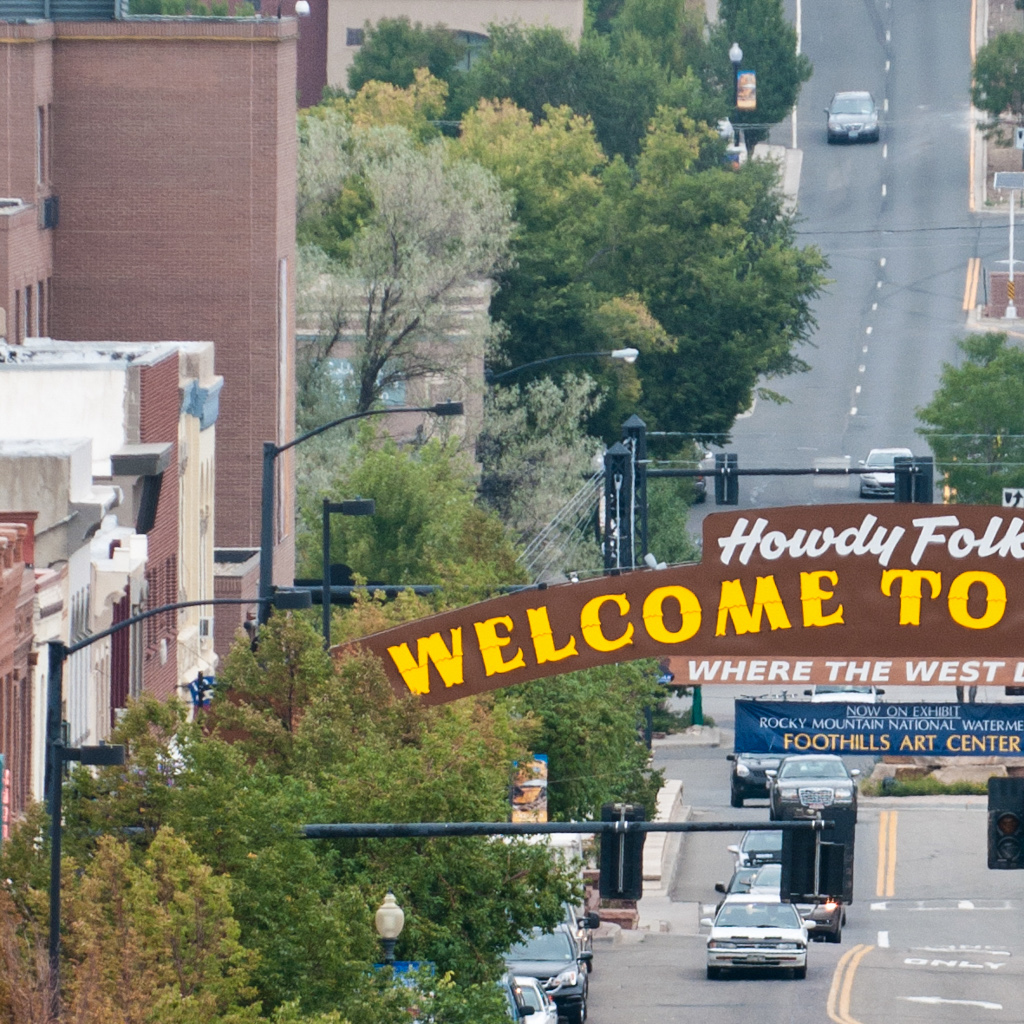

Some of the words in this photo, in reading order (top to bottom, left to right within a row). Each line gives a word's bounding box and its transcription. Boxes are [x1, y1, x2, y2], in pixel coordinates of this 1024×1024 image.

[718, 514, 905, 566] Howdy
[387, 570, 845, 696] WELCOME
[881, 569, 1007, 629] TO
[688, 660, 813, 681] WHERE
[825, 661, 892, 681] THE
[905, 661, 1006, 682] WEST
[847, 705, 882, 716] NOW
[887, 705, 908, 716] ON
[913, 706, 960, 717] EXHIBIT
[760, 717, 806, 729] ROCKY
[812, 718, 884, 730] MOUNTAIN
[889, 719, 956, 731] NATIONAL
[784, 733, 890, 751] FOOTHILLS
[900, 735, 937, 751] ART
[946, 735, 1021, 752] CENTER
[903, 958, 1007, 970] ONLY
